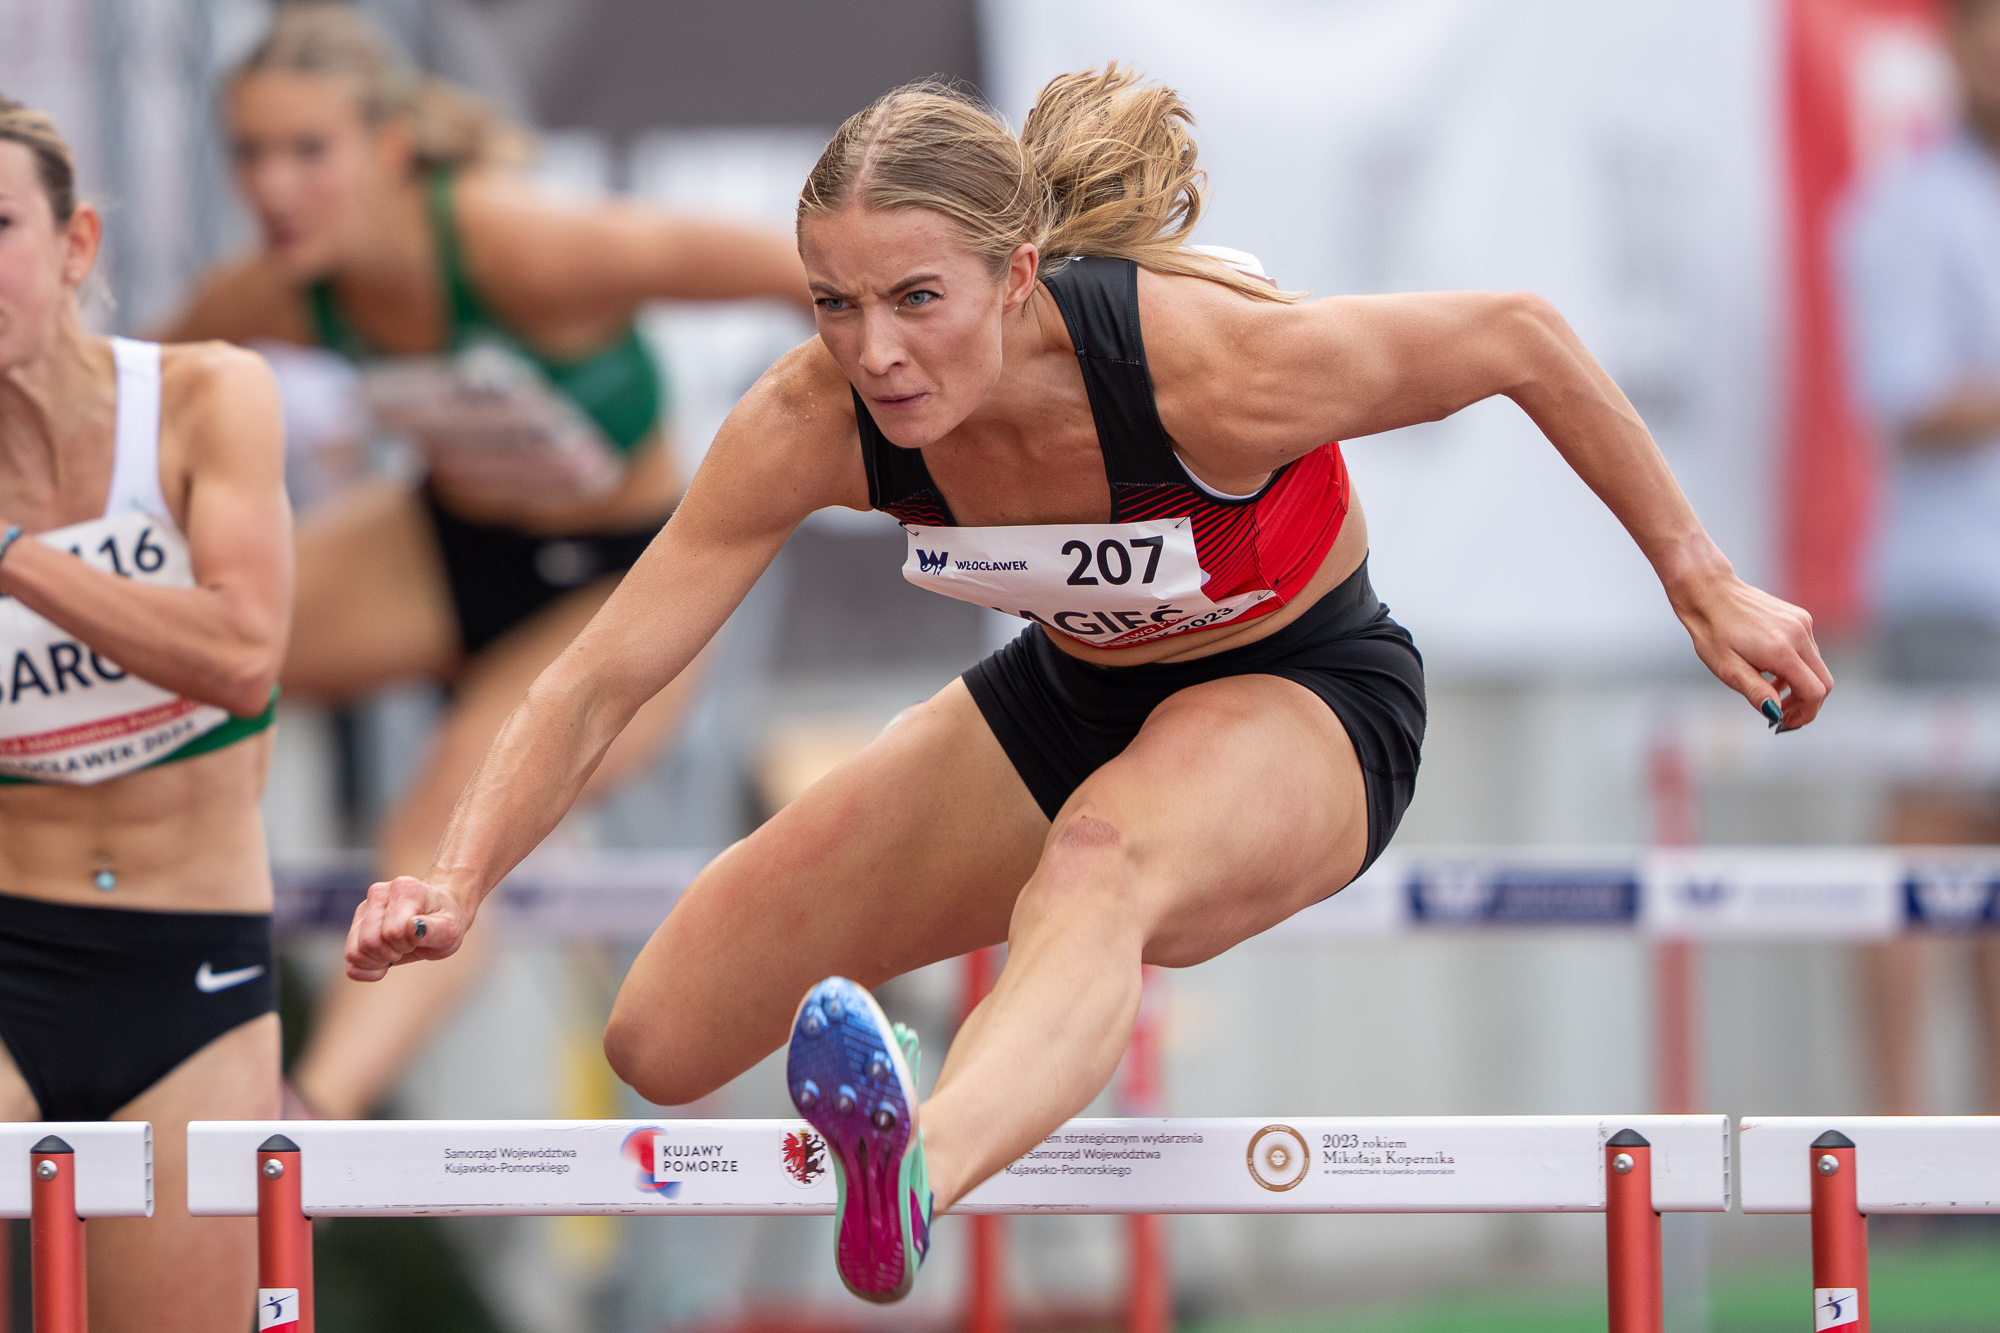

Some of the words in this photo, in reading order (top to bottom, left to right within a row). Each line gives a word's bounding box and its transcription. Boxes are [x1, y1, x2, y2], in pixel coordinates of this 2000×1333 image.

[69, 527, 165, 578] 16
[954, 560, 1029, 571] WŁOCŁAWEK
[1061, 535, 1164, 586] 207
[1064, 1132, 1140, 1146] strategicznym
[1141, 1132, 1204, 1146] wydarzenia
[1321, 1134, 1359, 1149] 2023
[1361, 1135, 1407, 1149] rokiem
[444, 1148, 497, 1161] Samorząd
[499, 1147, 577, 1161] Województwa
[663, 1145, 724, 1157] KUJAWY
[1027, 1148, 1081, 1162] Samorząd
[1082, 1148, 1161, 1162] Województwa
[1322, 1150, 1382, 1167] Mikołaja
[1385, 1150, 1455, 1167] Kopernika
[444, 1162, 571, 1175] Kujawsko-Pomorskiego
[663, 1160, 739, 1173] POMORZE
[1004, 1163, 1133, 1178] Kujawsko-Pomorskiego
[1332, 1167, 1381, 1176] województwie
